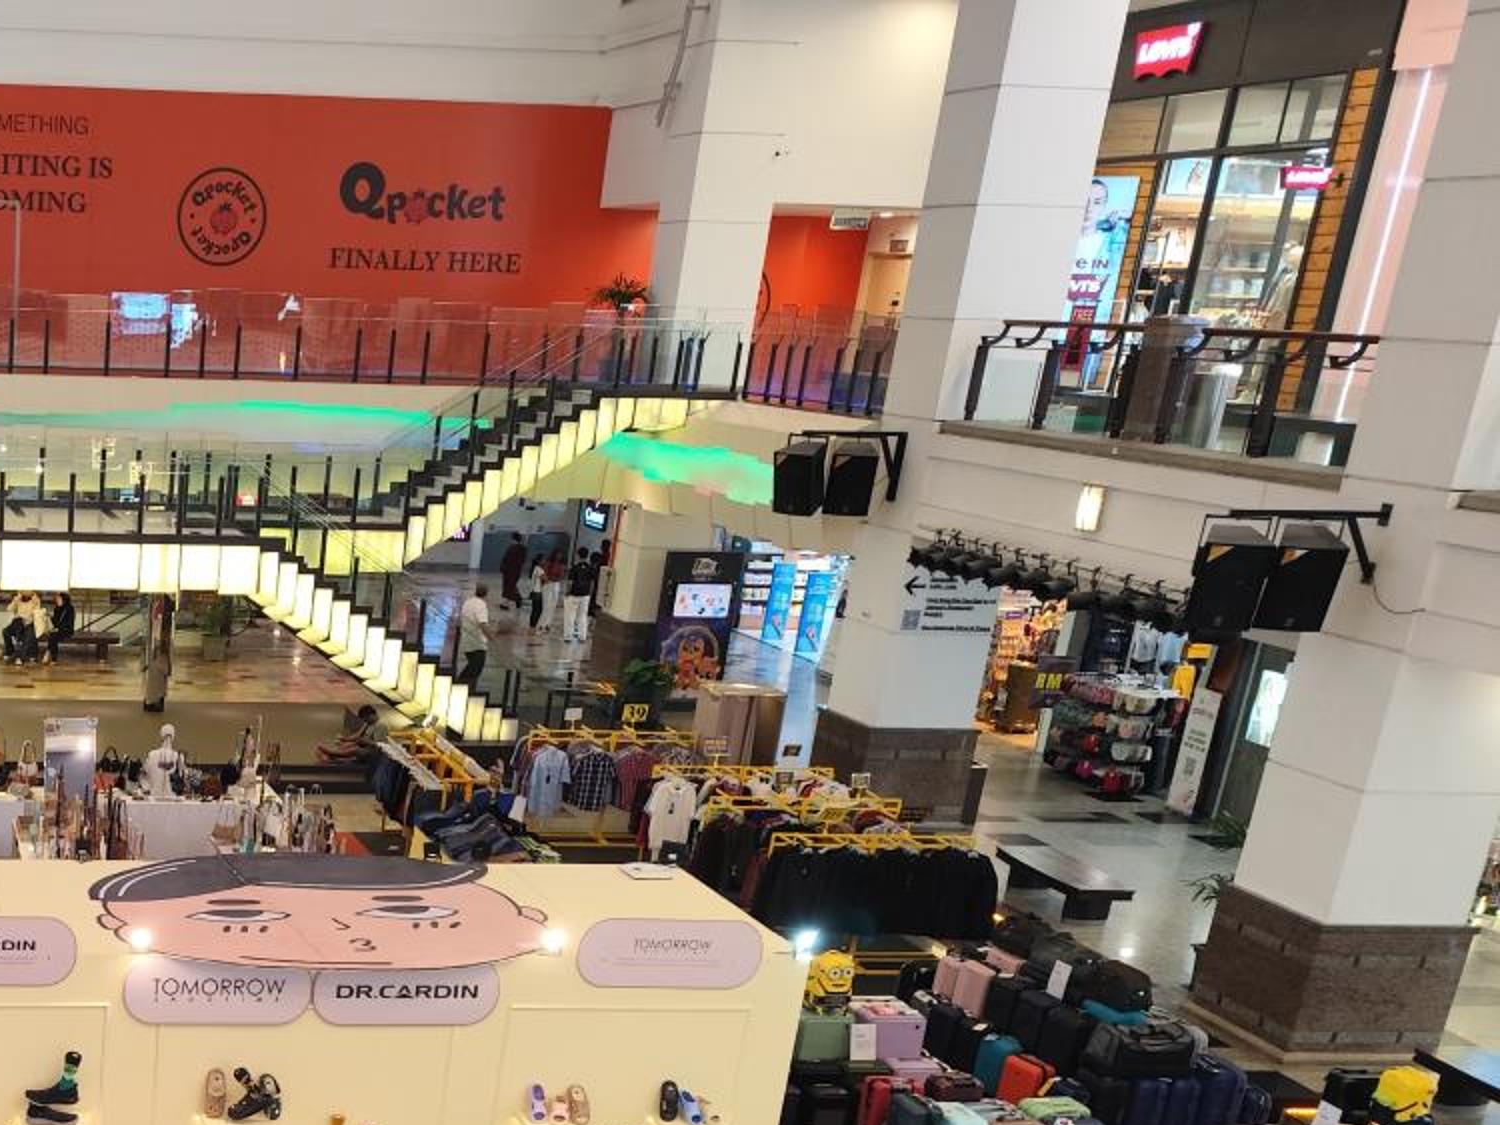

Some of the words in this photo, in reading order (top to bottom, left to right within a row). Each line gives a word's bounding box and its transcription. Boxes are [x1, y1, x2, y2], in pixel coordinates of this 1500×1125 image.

[77, 155, 113, 179] IS
[330, 247, 441, 273] FINALLY
[447, 251, 521, 274] HERE
[633, 938, 713, 953] TOMORROW
[152, 977, 287, 996] TOMORROW
[335, 983, 479, 1000] DR.CARDIN
